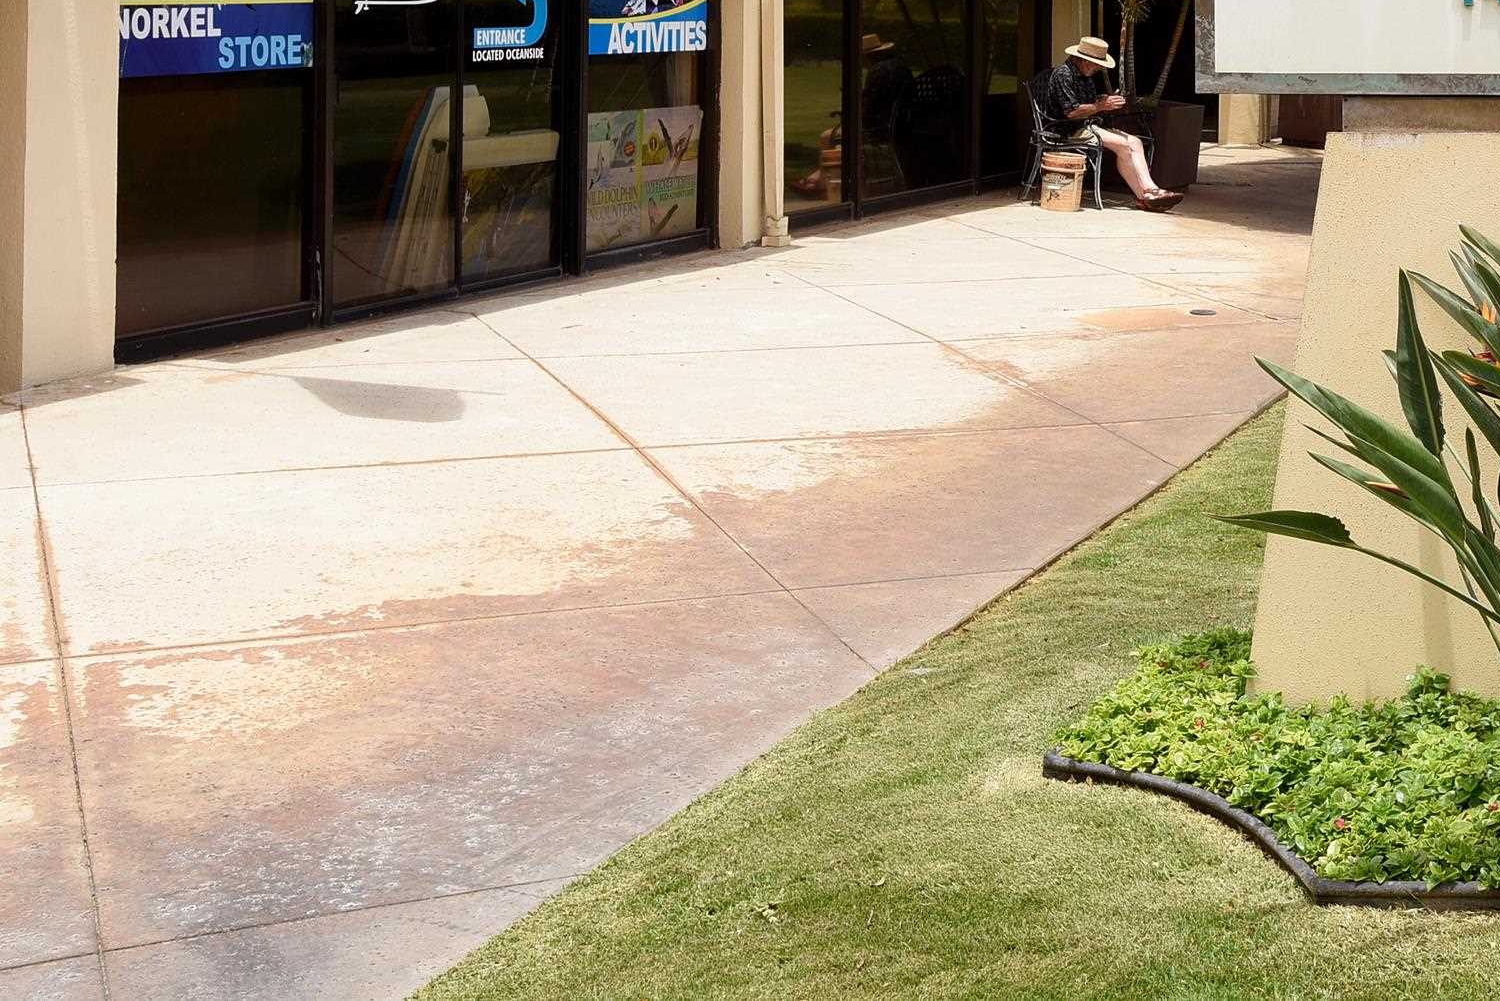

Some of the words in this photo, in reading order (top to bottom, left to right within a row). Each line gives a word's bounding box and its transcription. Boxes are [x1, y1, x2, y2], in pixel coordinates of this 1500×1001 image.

[476, 29, 526, 46] ENTRANCE
[608, 21, 707, 55] ACTIVITIES
[218, 35, 302, 69] STORE
[472, 49, 504, 62] LOCATED
[506, 48, 544, 61] OCEANSIDE
